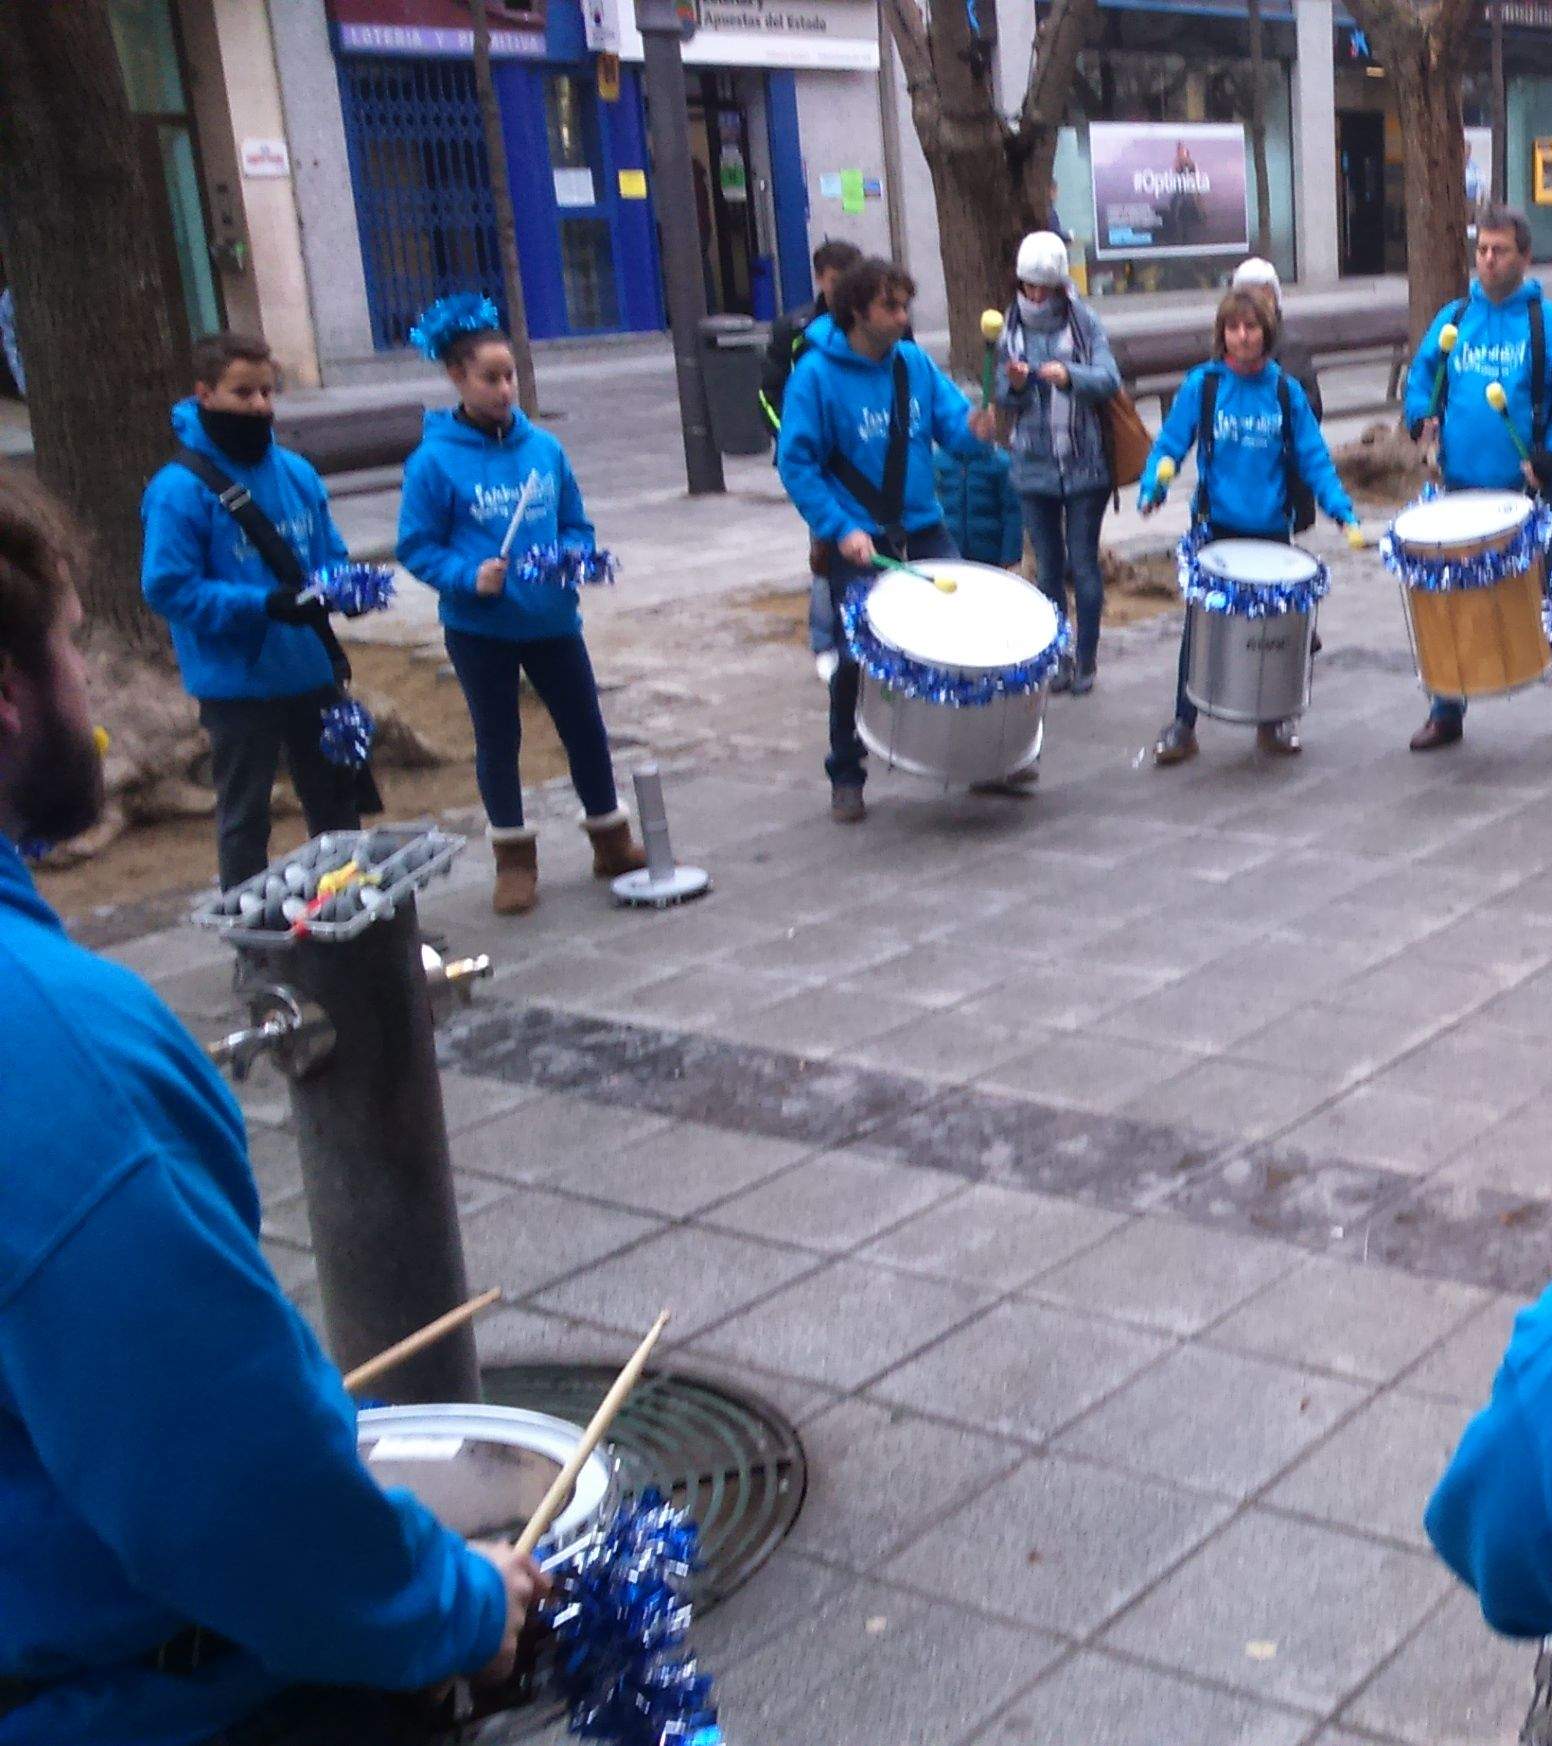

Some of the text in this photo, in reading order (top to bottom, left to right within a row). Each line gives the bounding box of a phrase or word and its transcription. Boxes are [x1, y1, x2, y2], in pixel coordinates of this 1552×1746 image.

[703, 11, 827, 33] Apuestas del Estado
[1133, 166, 1211, 199] #Optimista
